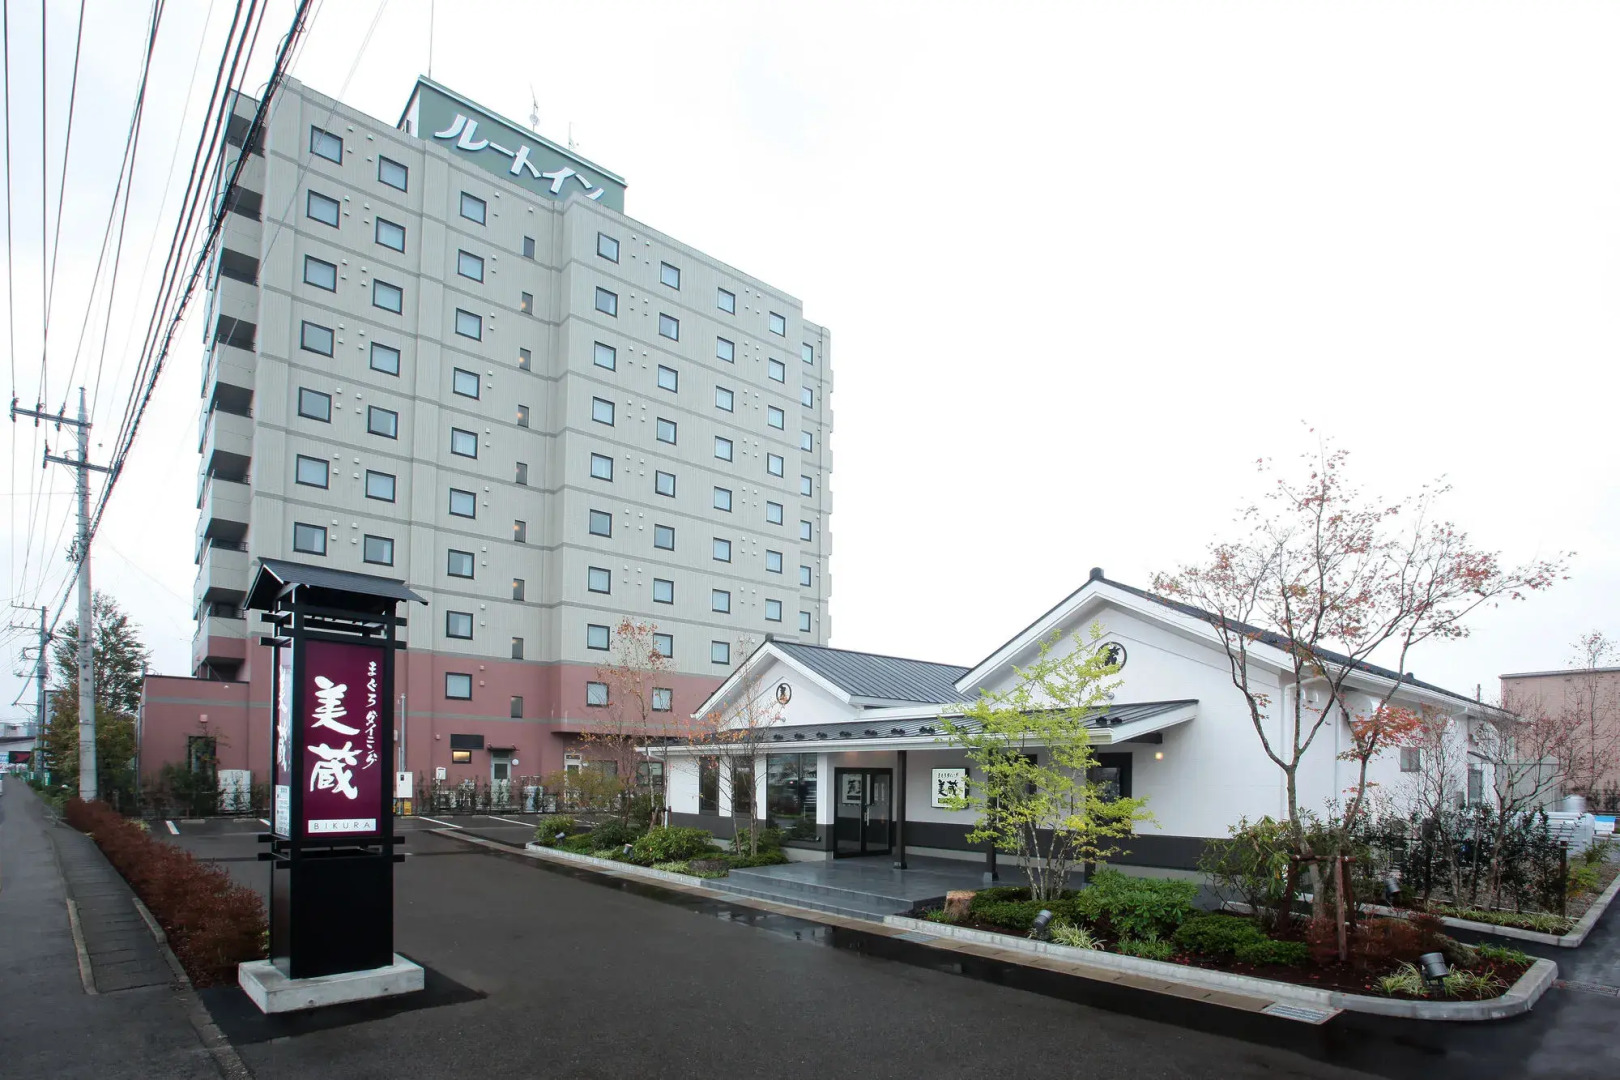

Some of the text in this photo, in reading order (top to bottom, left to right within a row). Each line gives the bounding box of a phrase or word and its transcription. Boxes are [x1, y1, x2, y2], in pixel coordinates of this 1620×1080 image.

[434, 113, 604, 201] ルートイン
[307, 675, 364, 800] 美蔵
[362, 661, 378, 769] まぐろダイニング
[313, 821, 371, 830] BIKURA
